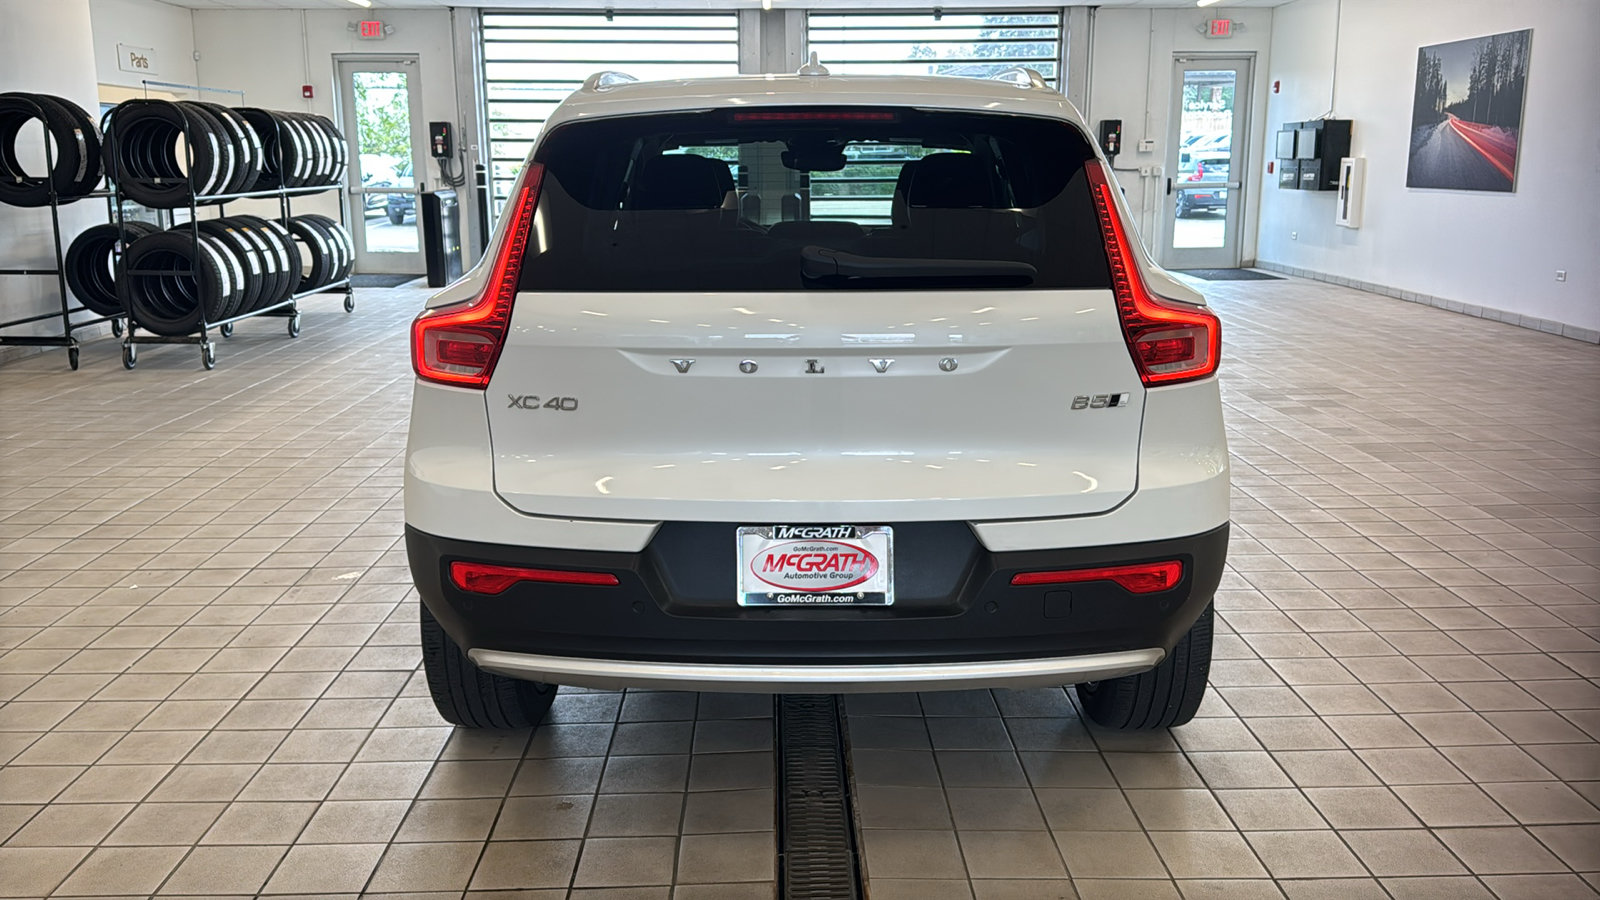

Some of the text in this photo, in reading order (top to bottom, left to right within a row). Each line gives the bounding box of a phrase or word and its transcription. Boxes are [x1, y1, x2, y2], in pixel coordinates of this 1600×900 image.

[360, 21, 380, 37] EXIT
[1211, 19, 1230, 35] EXIT
[130, 52, 149, 69] Parts
[669, 358, 958, 375] VOLVO
[784, 572, 854, 580] Automotive Group
[777, 594, 854, 604] GoMcGrath.com
